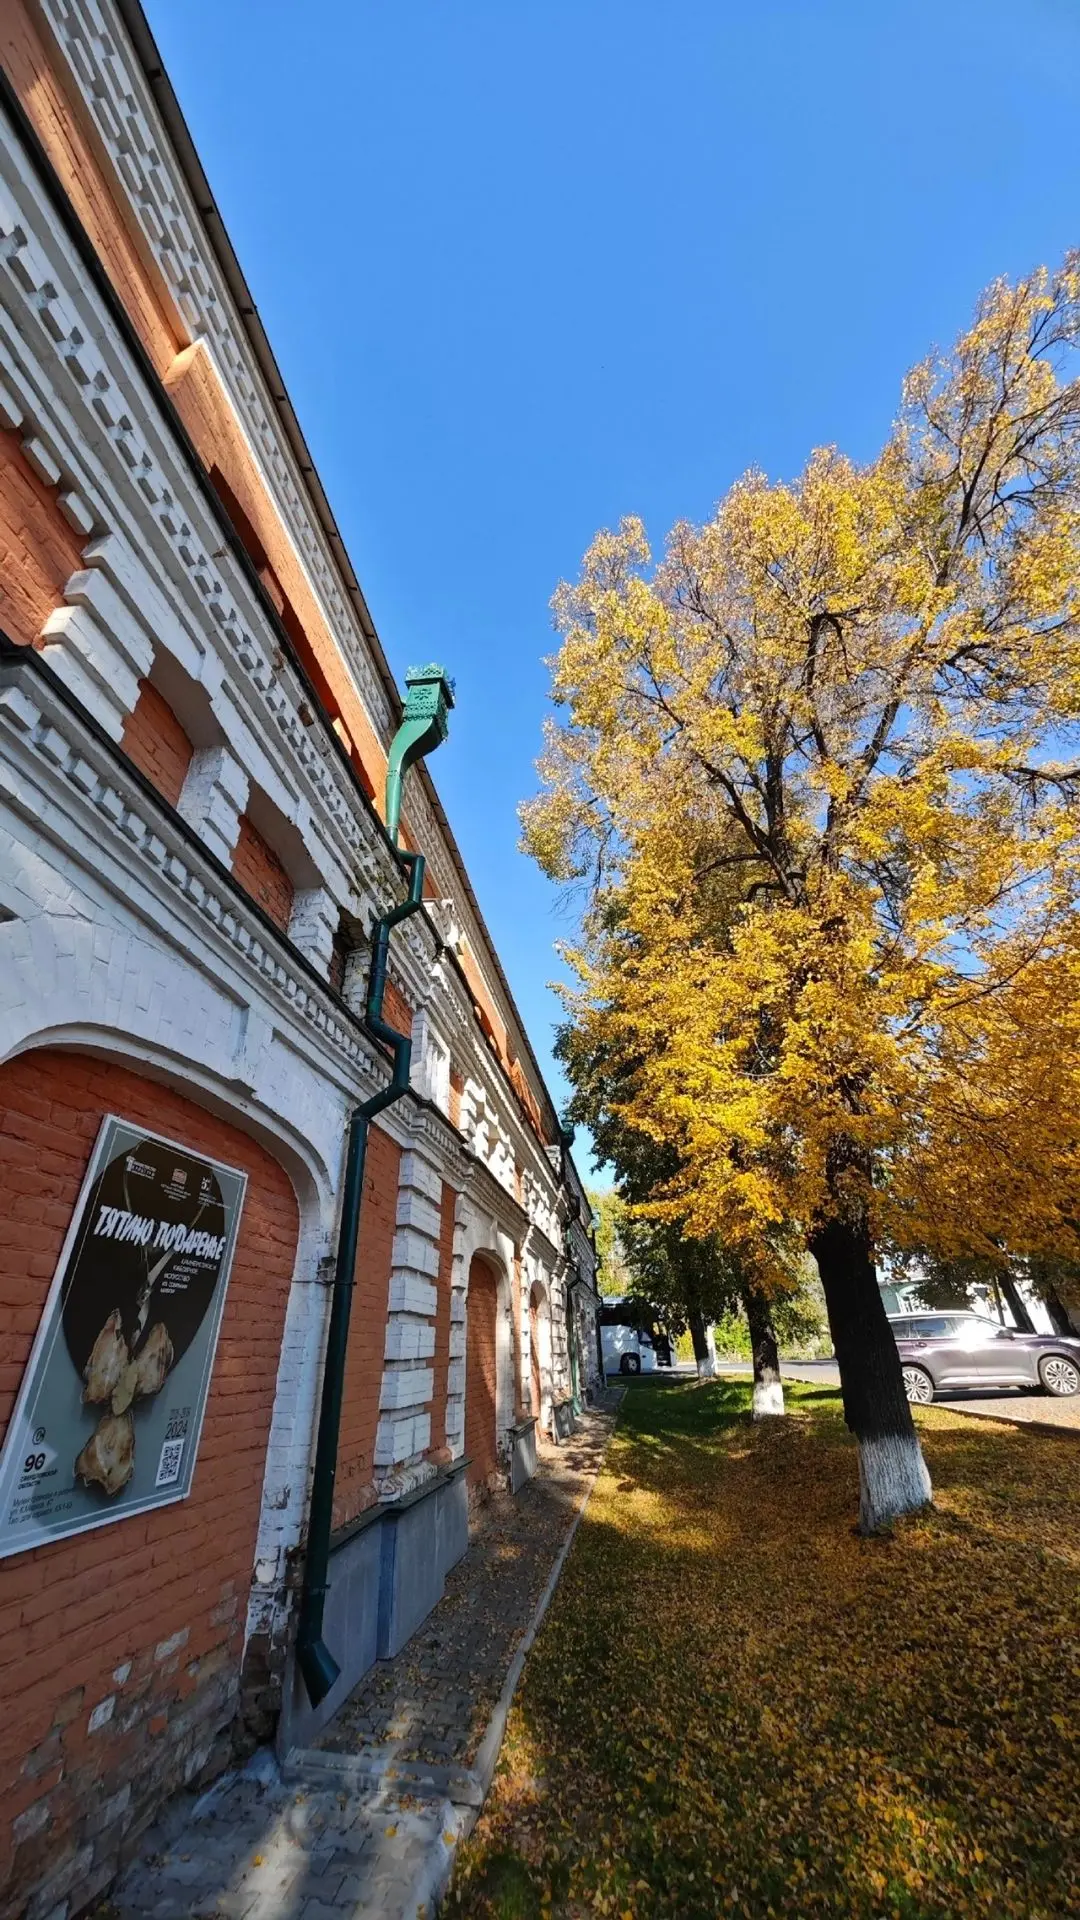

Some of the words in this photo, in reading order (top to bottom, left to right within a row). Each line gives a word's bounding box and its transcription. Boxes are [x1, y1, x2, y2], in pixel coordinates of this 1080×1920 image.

[94, 1205, 155, 1246] ТЯТИНО
[165, 1420, 188, 1439] 2024
[24, 1453, 46, 1473] 90
